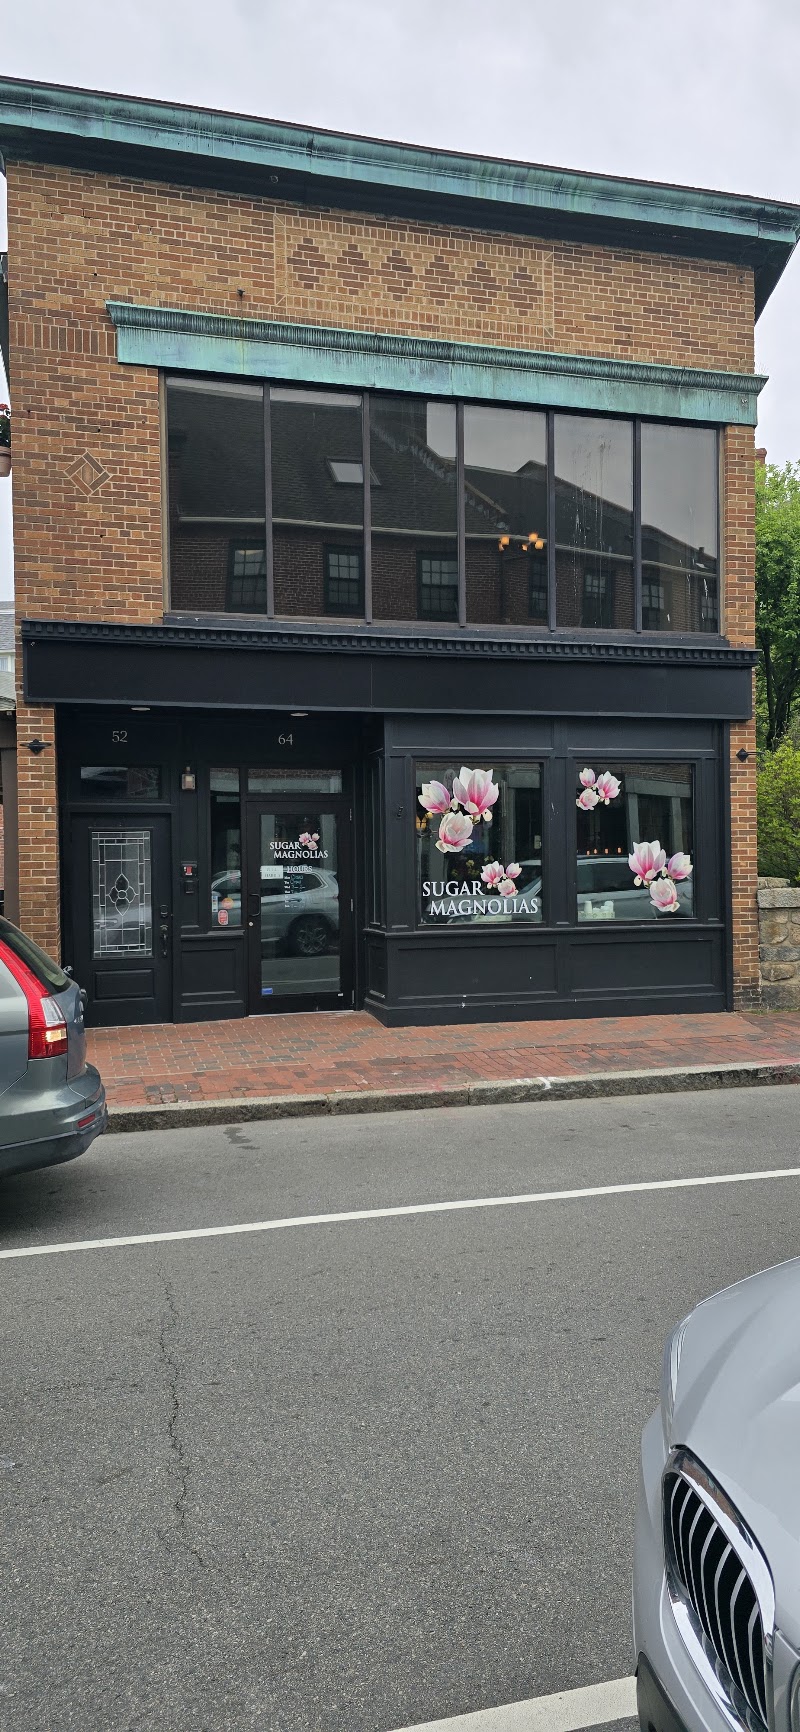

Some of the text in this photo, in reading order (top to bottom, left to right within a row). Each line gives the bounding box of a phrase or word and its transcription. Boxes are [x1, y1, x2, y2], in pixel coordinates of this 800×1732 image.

[112, 731, 128, 742] 52
[278, 734, 293, 745] 64
[269, 842, 301, 850] SUGAR
[274, 850, 328, 858] MAGNOLIAS
[422, 881, 485, 897] SUGAR
[430, 898, 538, 915] MAGNOLIAS
